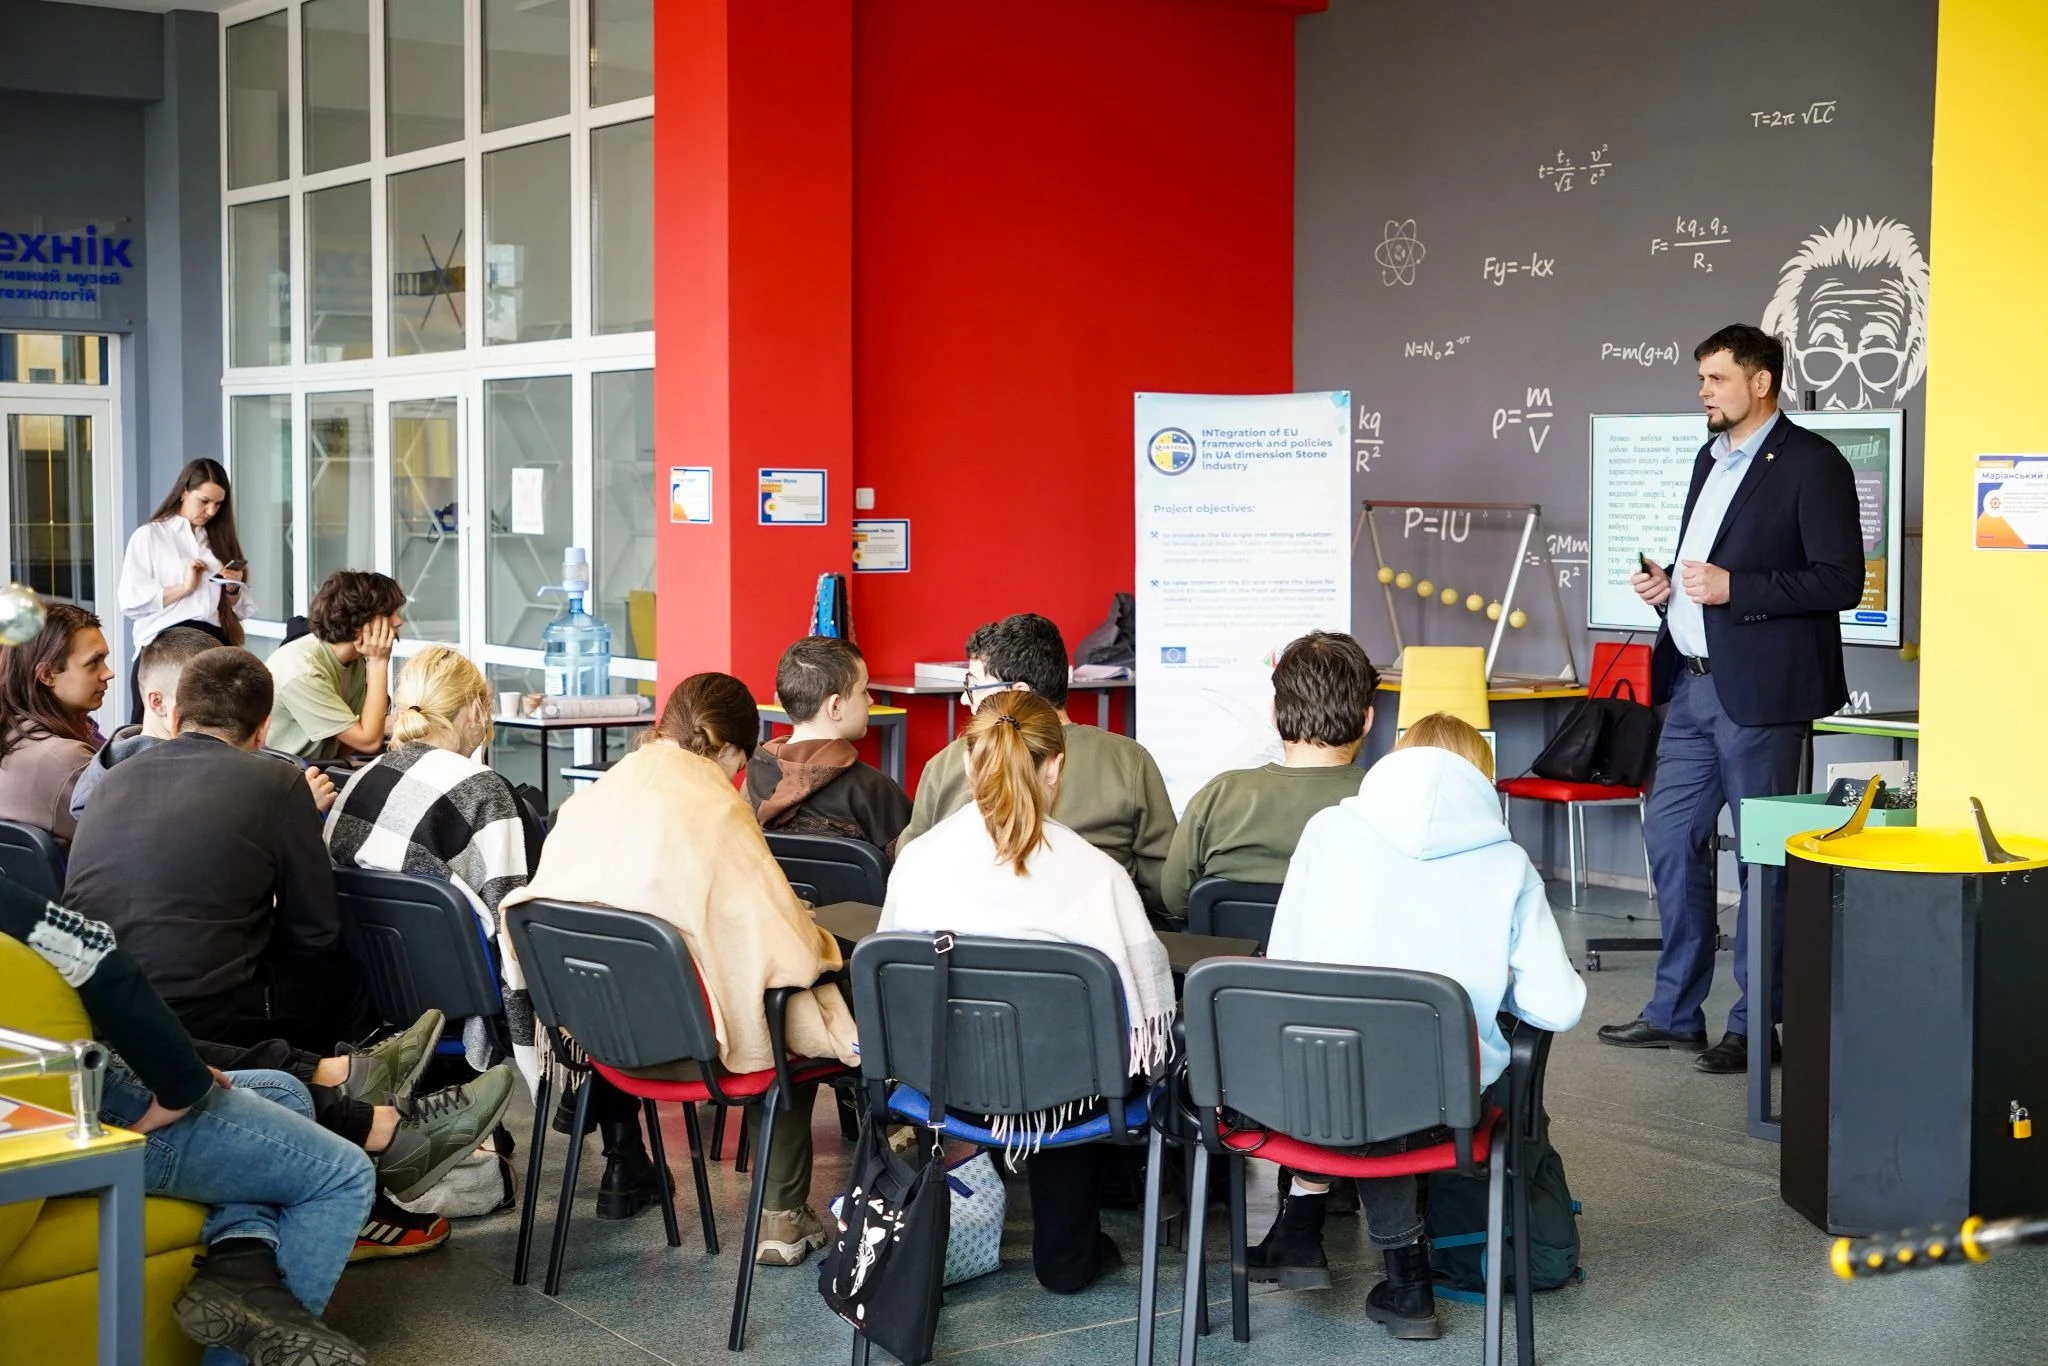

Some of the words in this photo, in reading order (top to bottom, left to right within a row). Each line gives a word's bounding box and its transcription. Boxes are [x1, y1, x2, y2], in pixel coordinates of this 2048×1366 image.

[66, 272, 122, 287] музей
[1202, 428, 1267, 439] INTegration
[1269, 427, 1280, 438] of
[1284, 427, 1299, 437] EU
[1202, 438, 1263, 449] framework
[1266, 438, 1287, 448] and
[1290, 438, 1333, 450] policies
[1202, 450, 1213, 460] in
[1215, 450, 1232, 459] UA
[1235, 449, 1293, 459] dimension
[1295, 449, 1328, 459] Stone
[1202, 460, 1249, 472] industry
[1153, 504, 1193, 515] Project
[1196, 504, 1256, 515] objectives:
